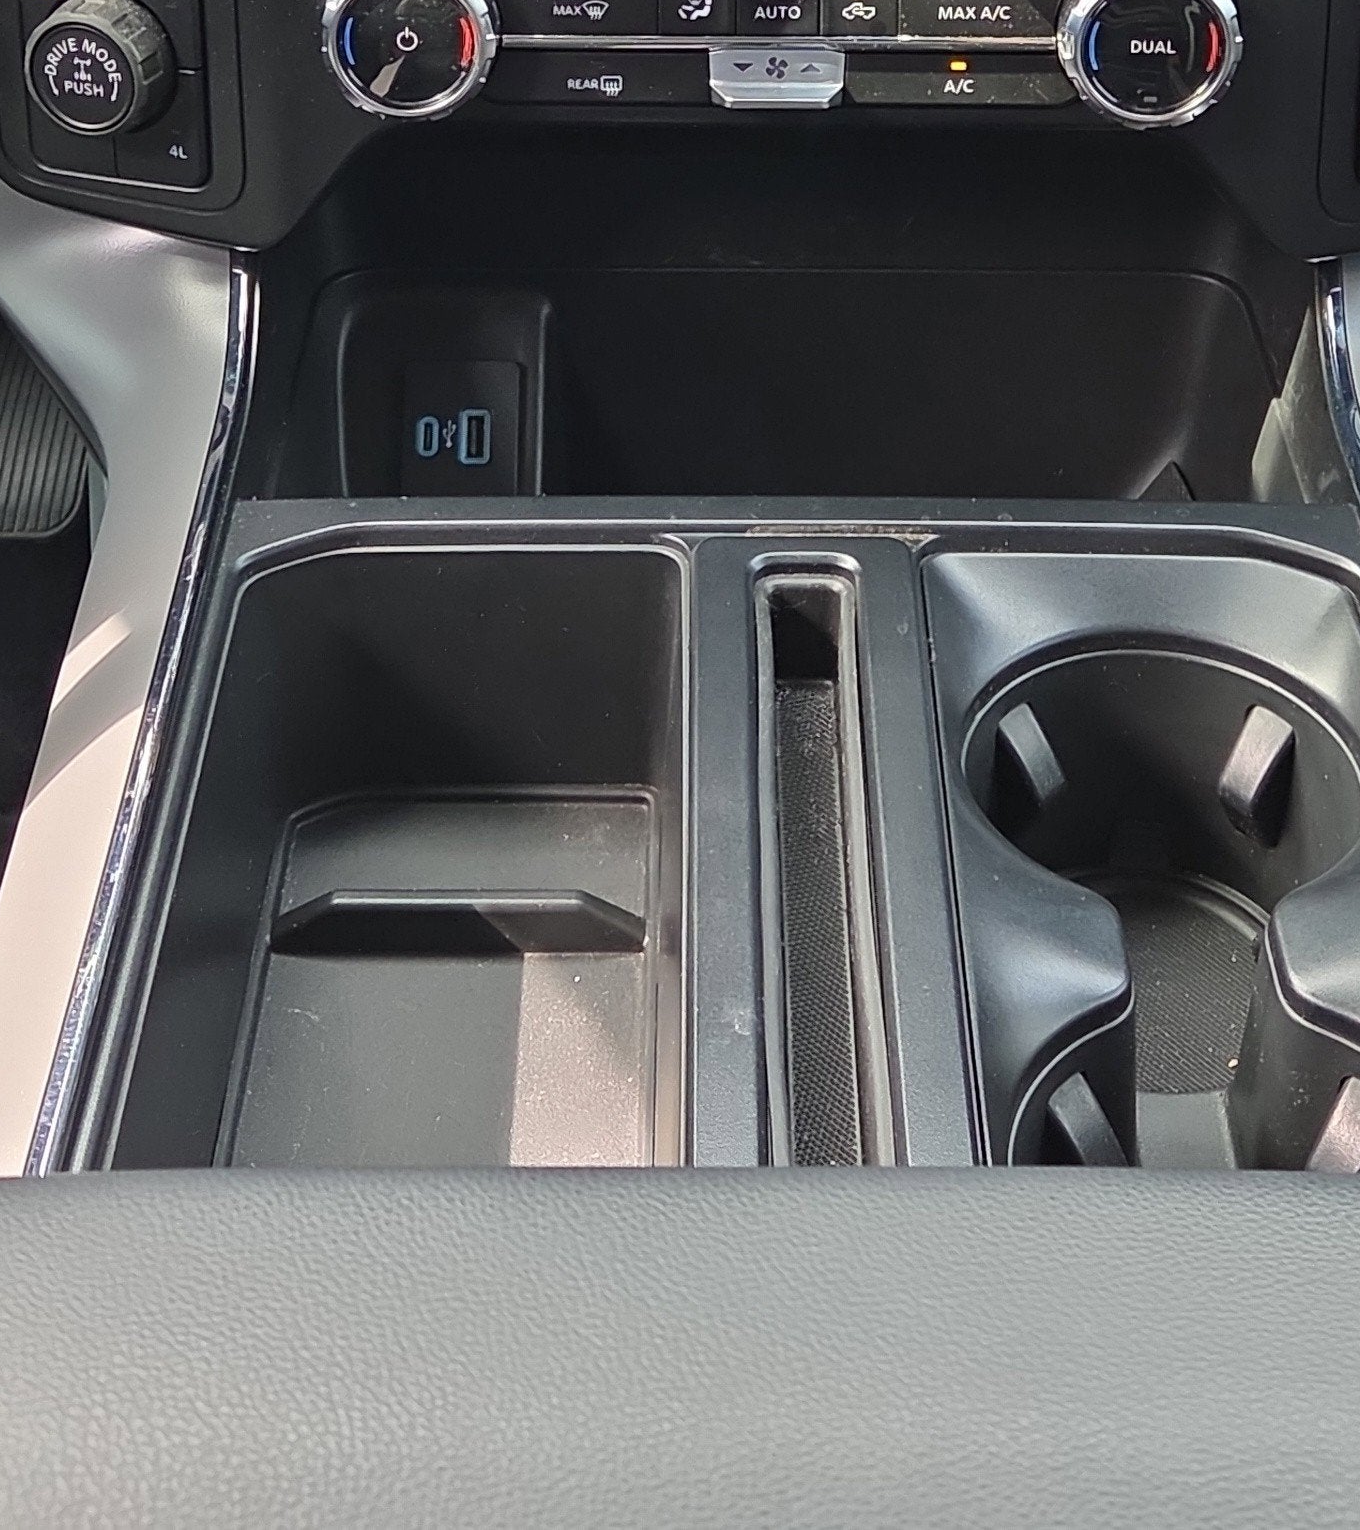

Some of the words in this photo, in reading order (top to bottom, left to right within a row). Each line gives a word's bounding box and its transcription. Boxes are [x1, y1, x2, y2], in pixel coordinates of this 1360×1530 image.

[553, 4, 582, 17] MAX
[754, 5, 801, 20] AUTO
[937, 6, 977, 21] MAX
[980, 5, 1012, 22] A/C
[1129, 39, 1177, 55] DUAL
[44, 37, 78, 76] DRIVE
[81, 38, 122, 83] MODE
[63, 79, 105, 98] PUSH
[566, 77, 600, 92] REAR
[943, 78, 975, 95] A/C
[168, 144, 188, 160] 4L
